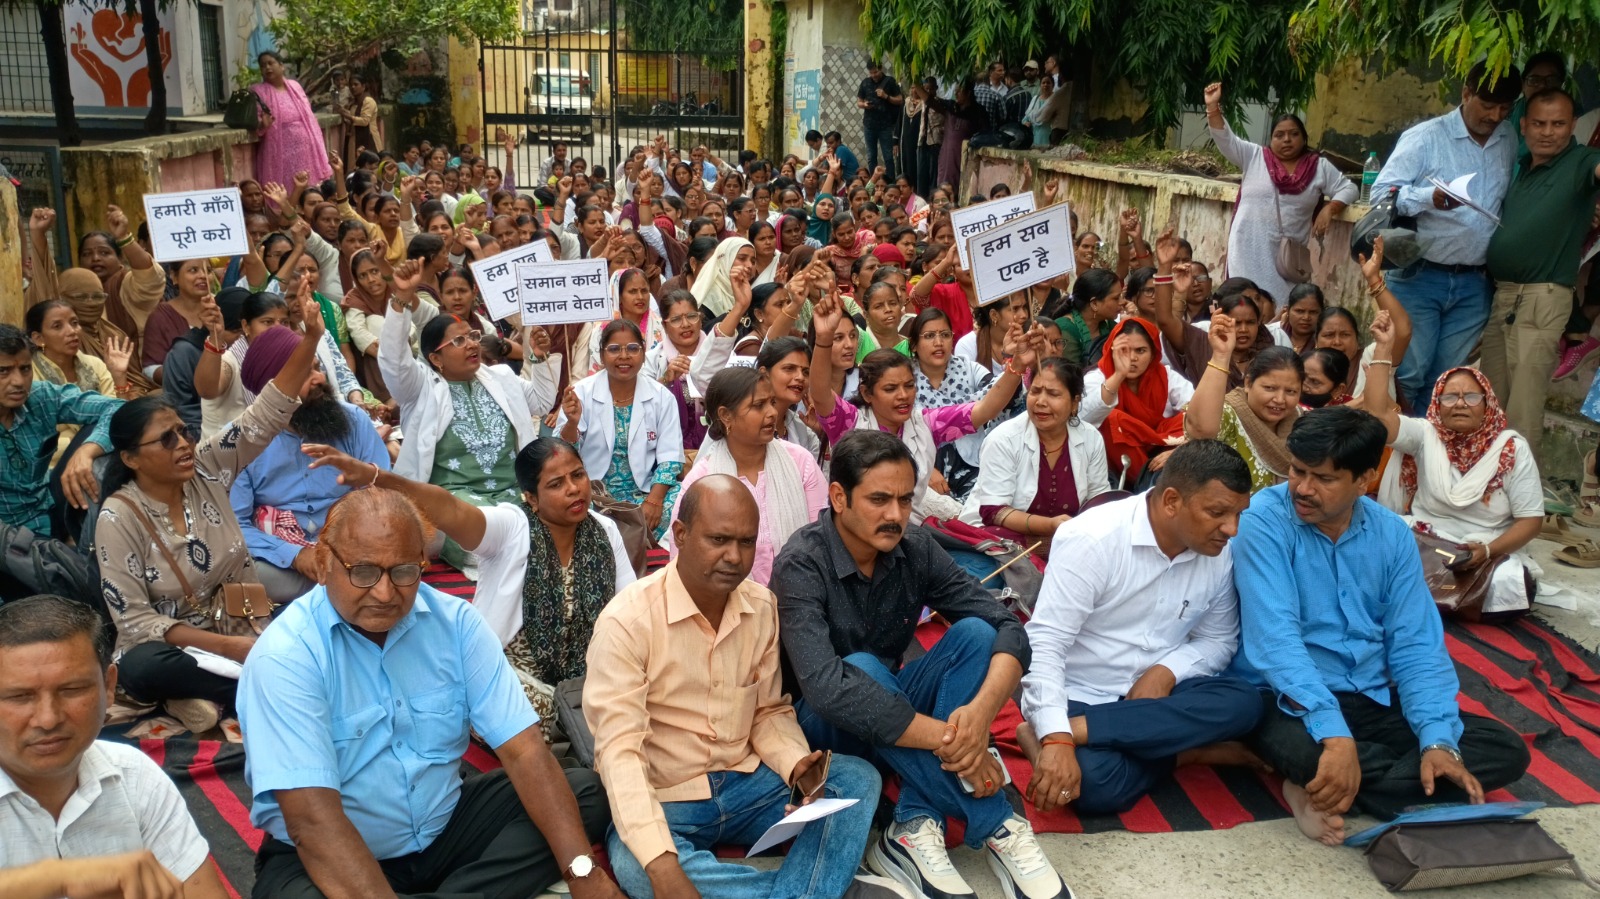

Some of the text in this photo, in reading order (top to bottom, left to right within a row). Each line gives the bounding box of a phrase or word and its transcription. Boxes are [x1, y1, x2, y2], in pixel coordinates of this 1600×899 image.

[152, 195, 235, 219] हमारी माँगे
[170, 223, 231, 249] पूरी करो
[959, 213, 998, 237] हमारी
[981, 219, 1050, 257] हम सब
[483, 262, 509, 282] हम
[997, 246, 1050, 281] एक है
[523, 268, 602, 290] समान कार्य
[502, 287, 519, 303] ए
[525, 295, 605, 314] समान वेतन
